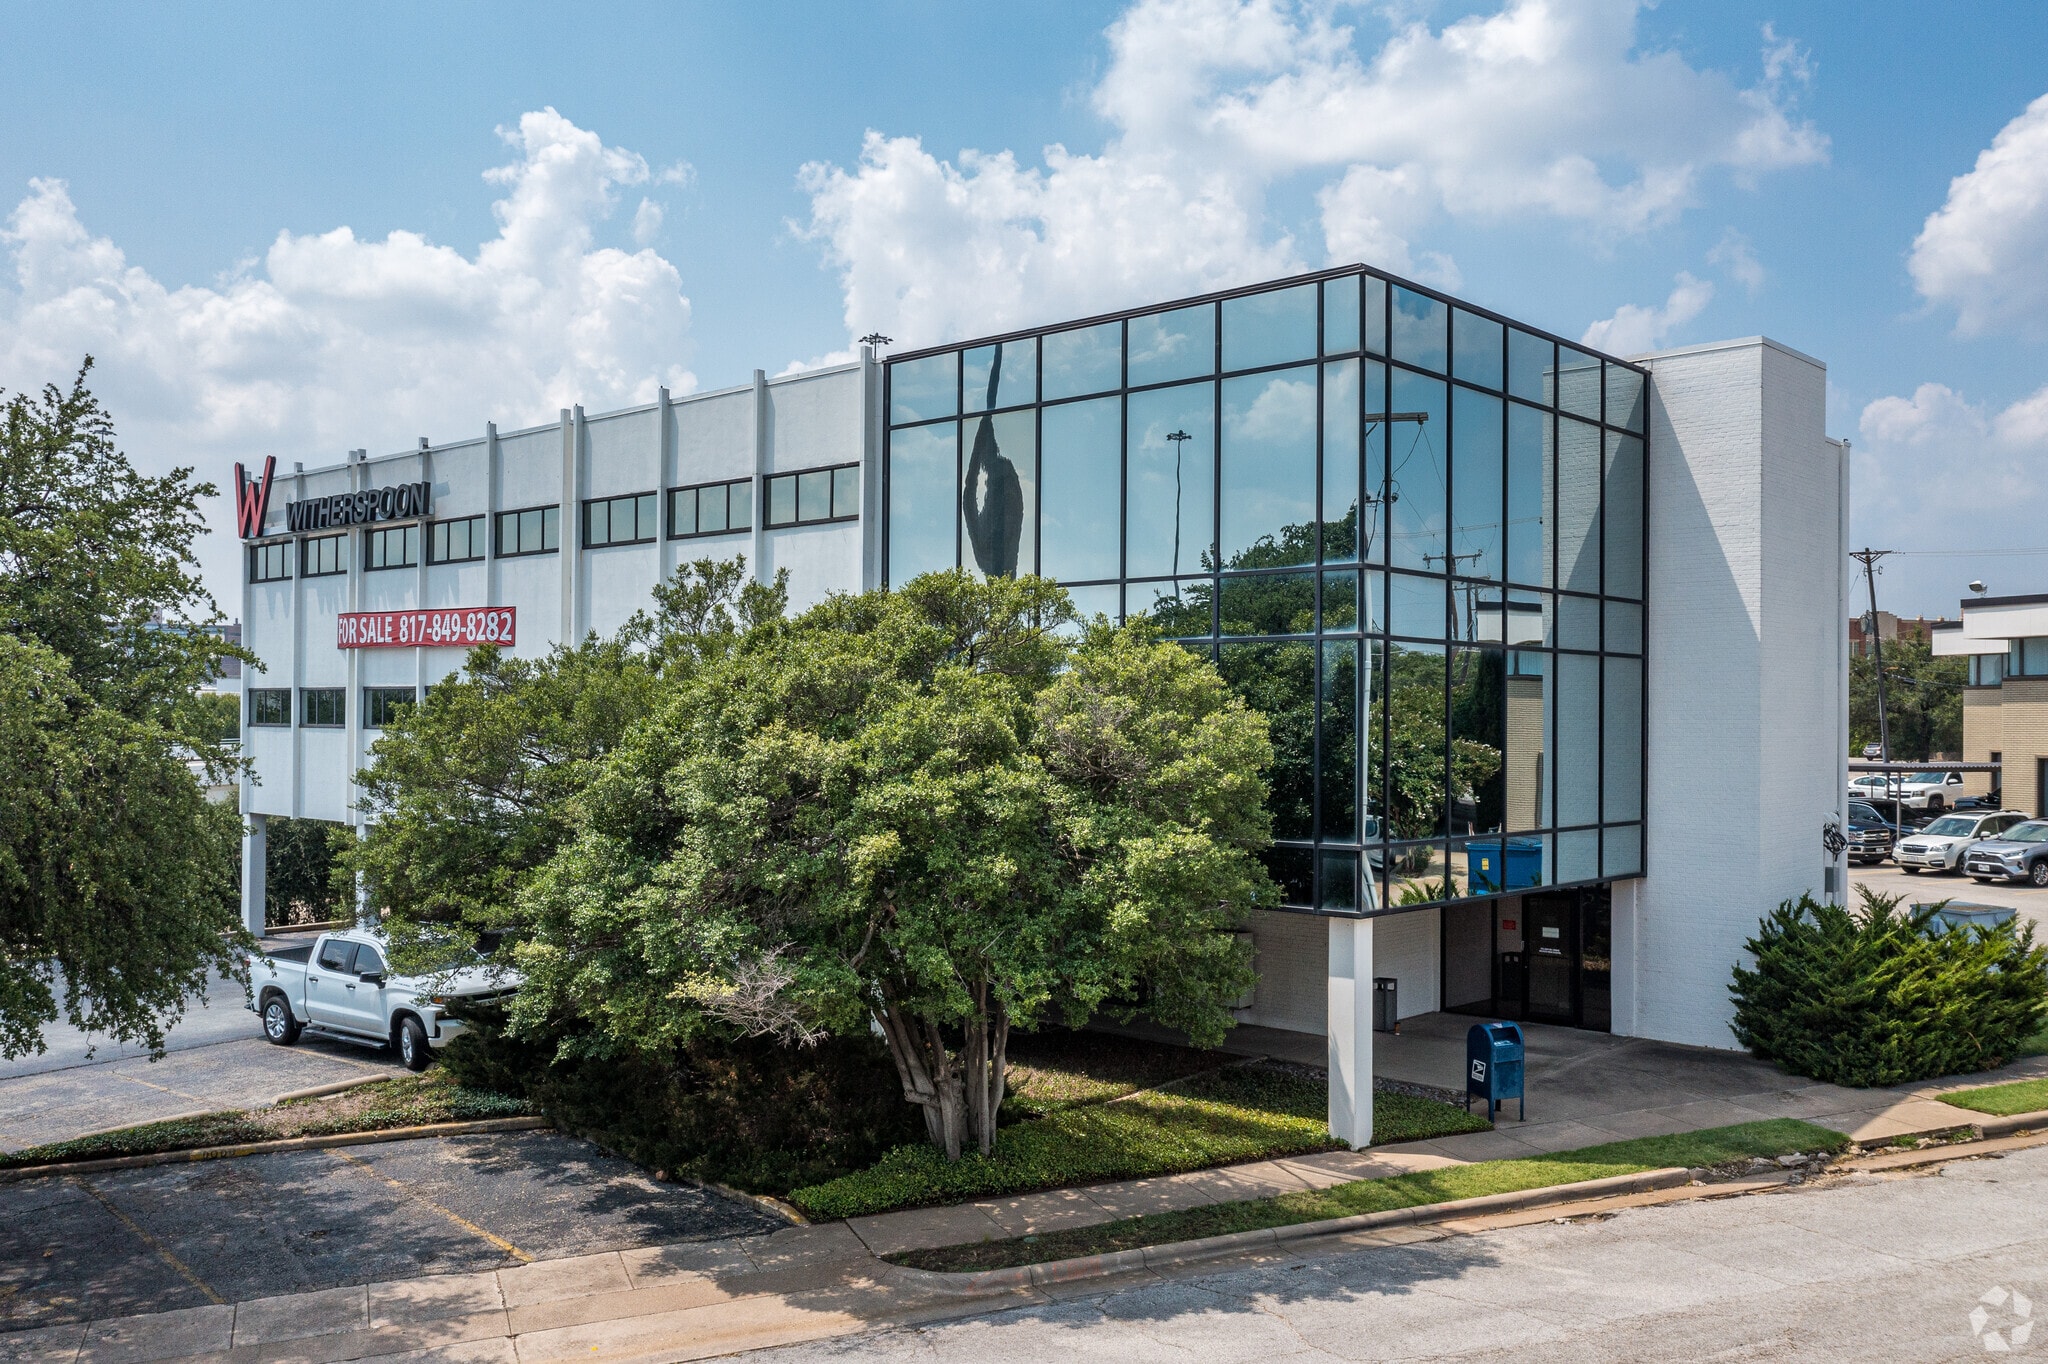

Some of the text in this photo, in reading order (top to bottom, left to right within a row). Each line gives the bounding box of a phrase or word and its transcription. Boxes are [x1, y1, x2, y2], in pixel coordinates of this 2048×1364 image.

[235, 455, 276, 539] W
[286, 481, 431, 531] WITHERSPOON
[339, 612, 512, 644] FOR SALE 817-849-8282
